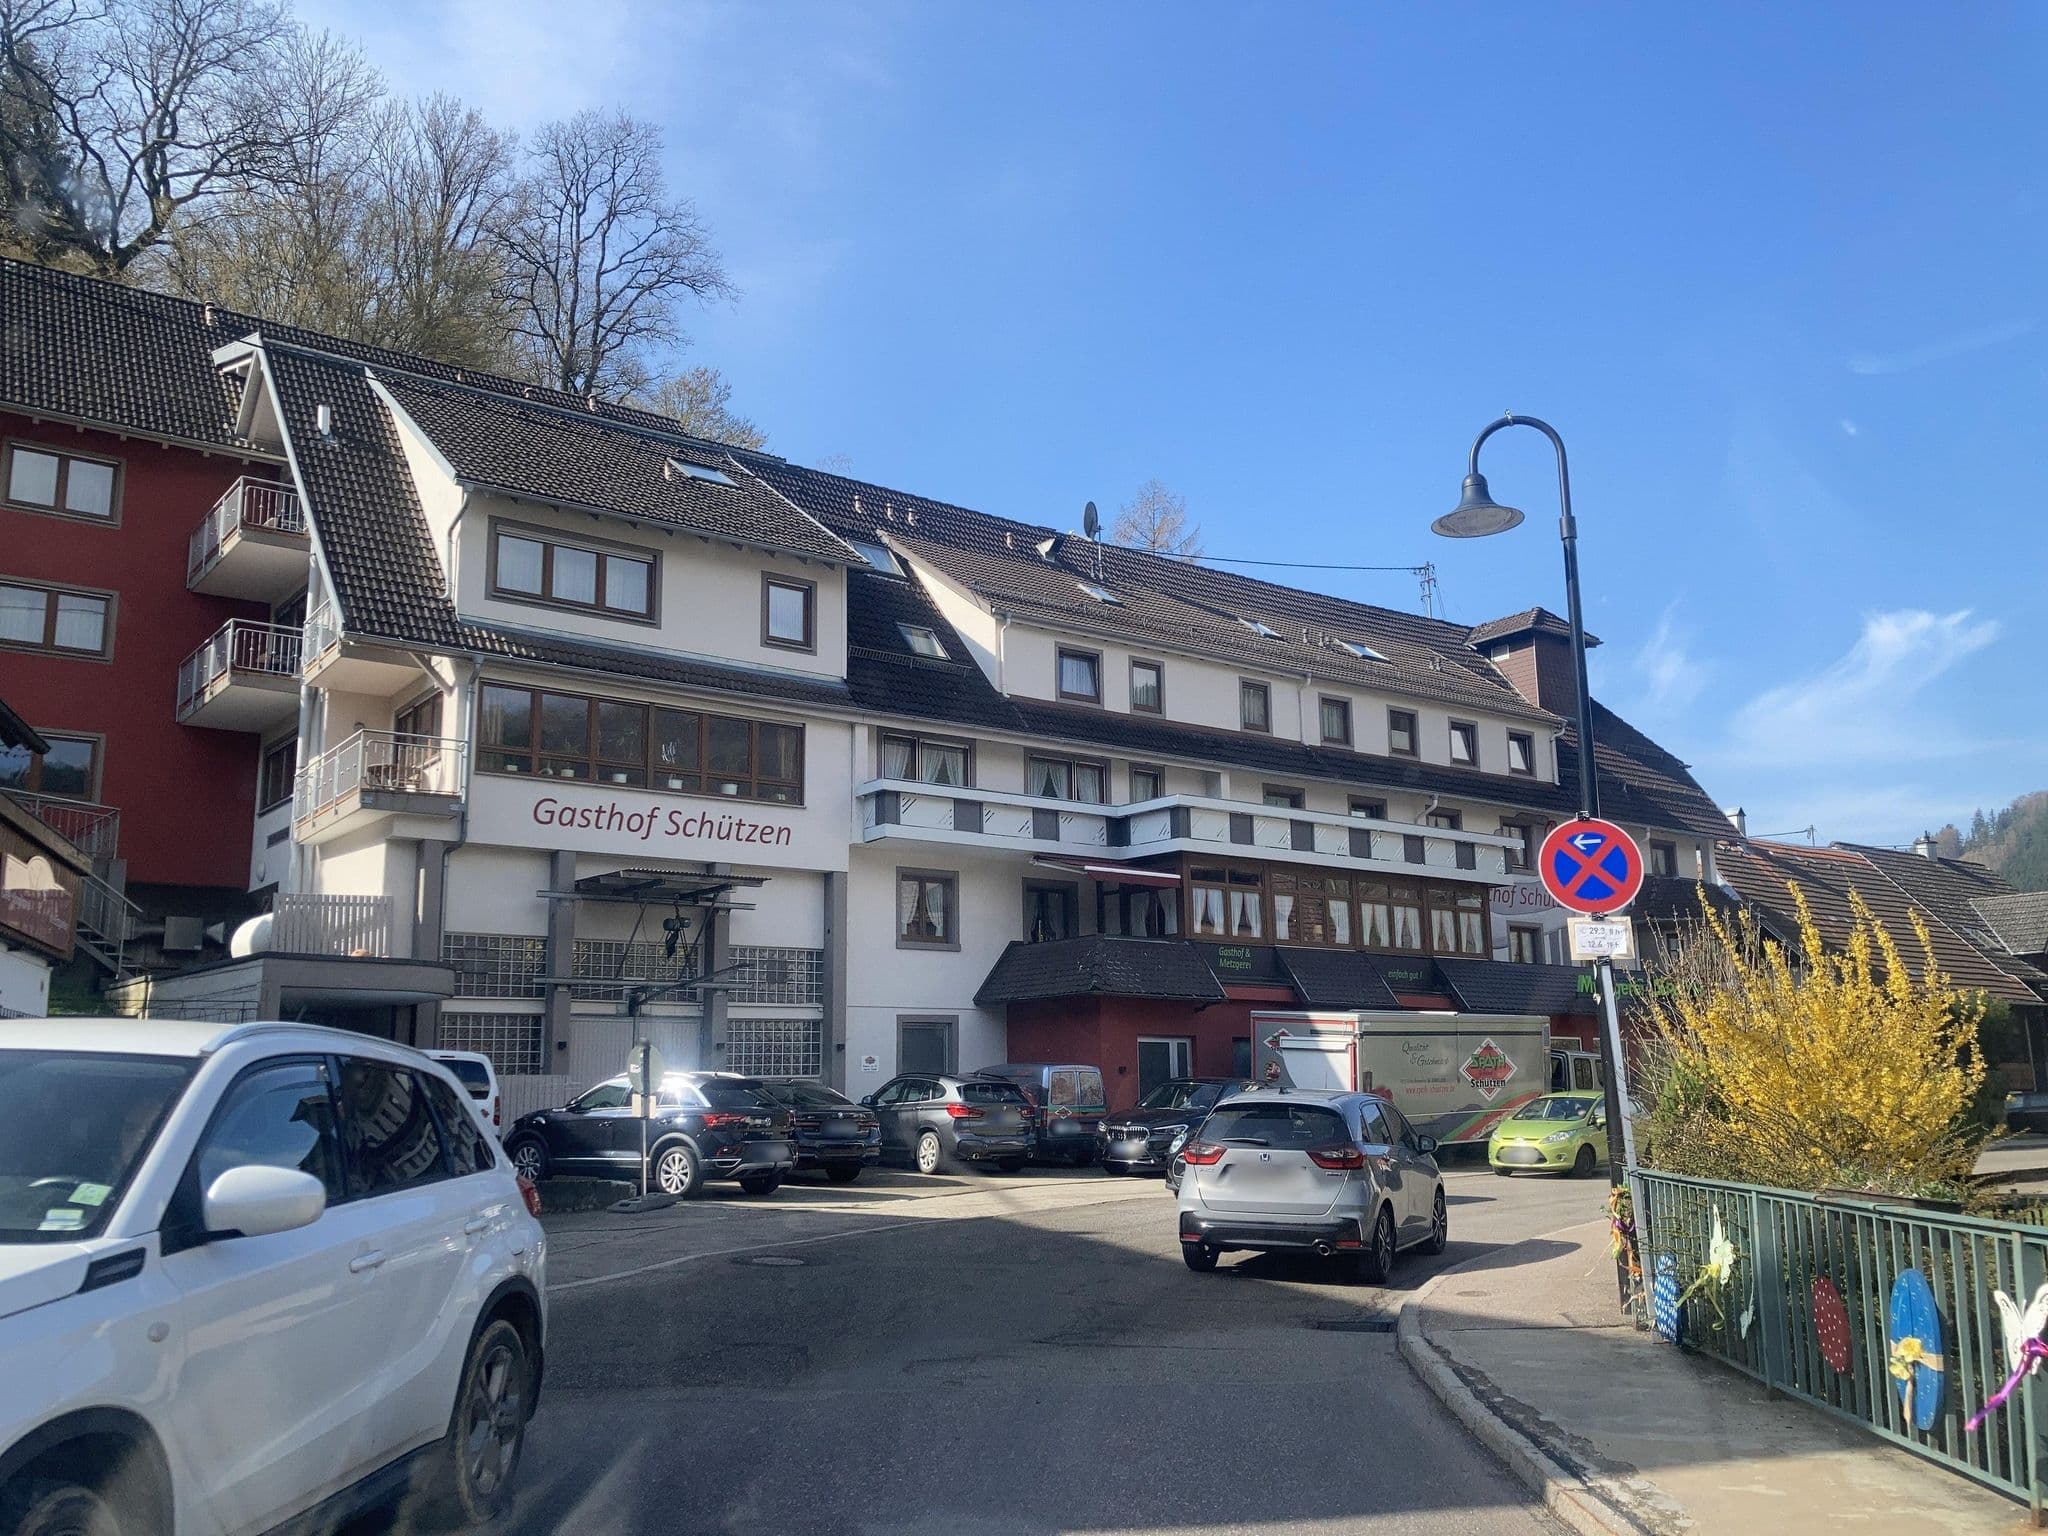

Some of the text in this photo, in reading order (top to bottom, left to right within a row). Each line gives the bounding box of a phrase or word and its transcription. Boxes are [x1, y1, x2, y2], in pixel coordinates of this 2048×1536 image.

[533, 797, 792, 846] Gasthof Schützen
[1218, 946, 1250, 959] Gasthof &
[1219, 959, 1252, 970] Metzgerei
[1471, 1078, 1506, 1088] Schützen
